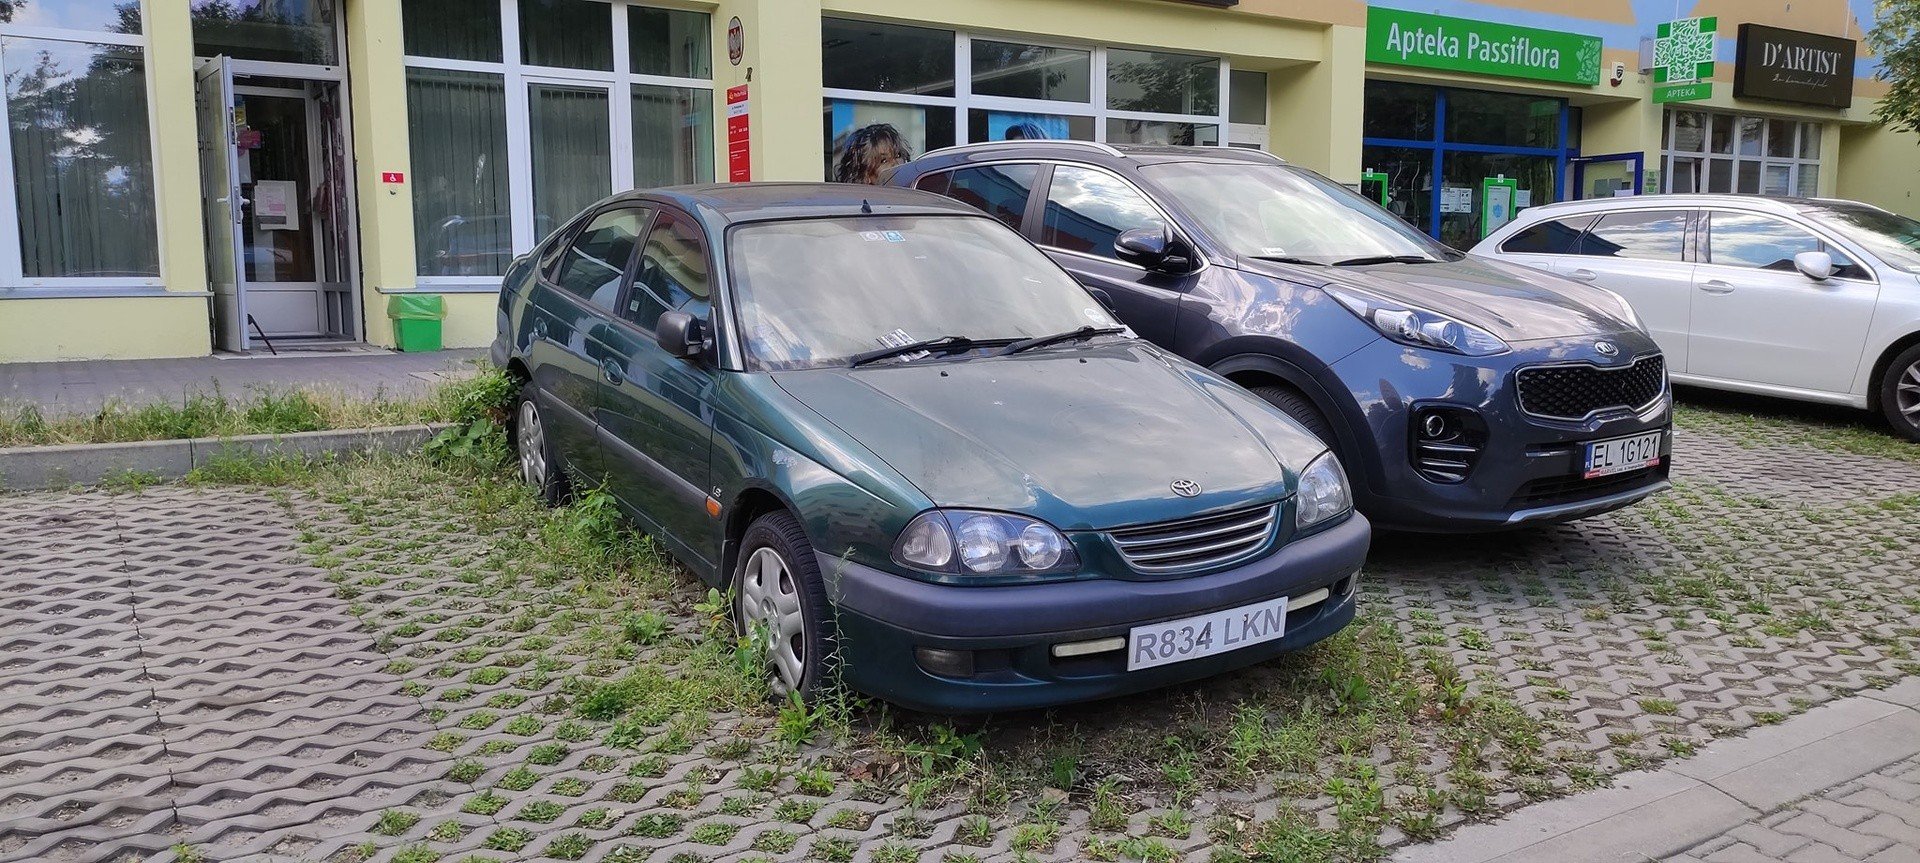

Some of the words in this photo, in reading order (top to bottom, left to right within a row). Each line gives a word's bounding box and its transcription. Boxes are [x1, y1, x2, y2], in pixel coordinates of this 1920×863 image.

[1386, 22, 1459, 60] Apteka
[1467, 32, 1560, 70] Passiflora
[1762, 42, 1842, 76] D'ARTIST
[1667, 88, 1696, 98] APTEKA
[1593, 444, 1613, 468] EL
[1620, 435, 1658, 464] 1G121
[1134, 621, 1213, 664] R834
[1223, 605, 1283, 646] LKN
